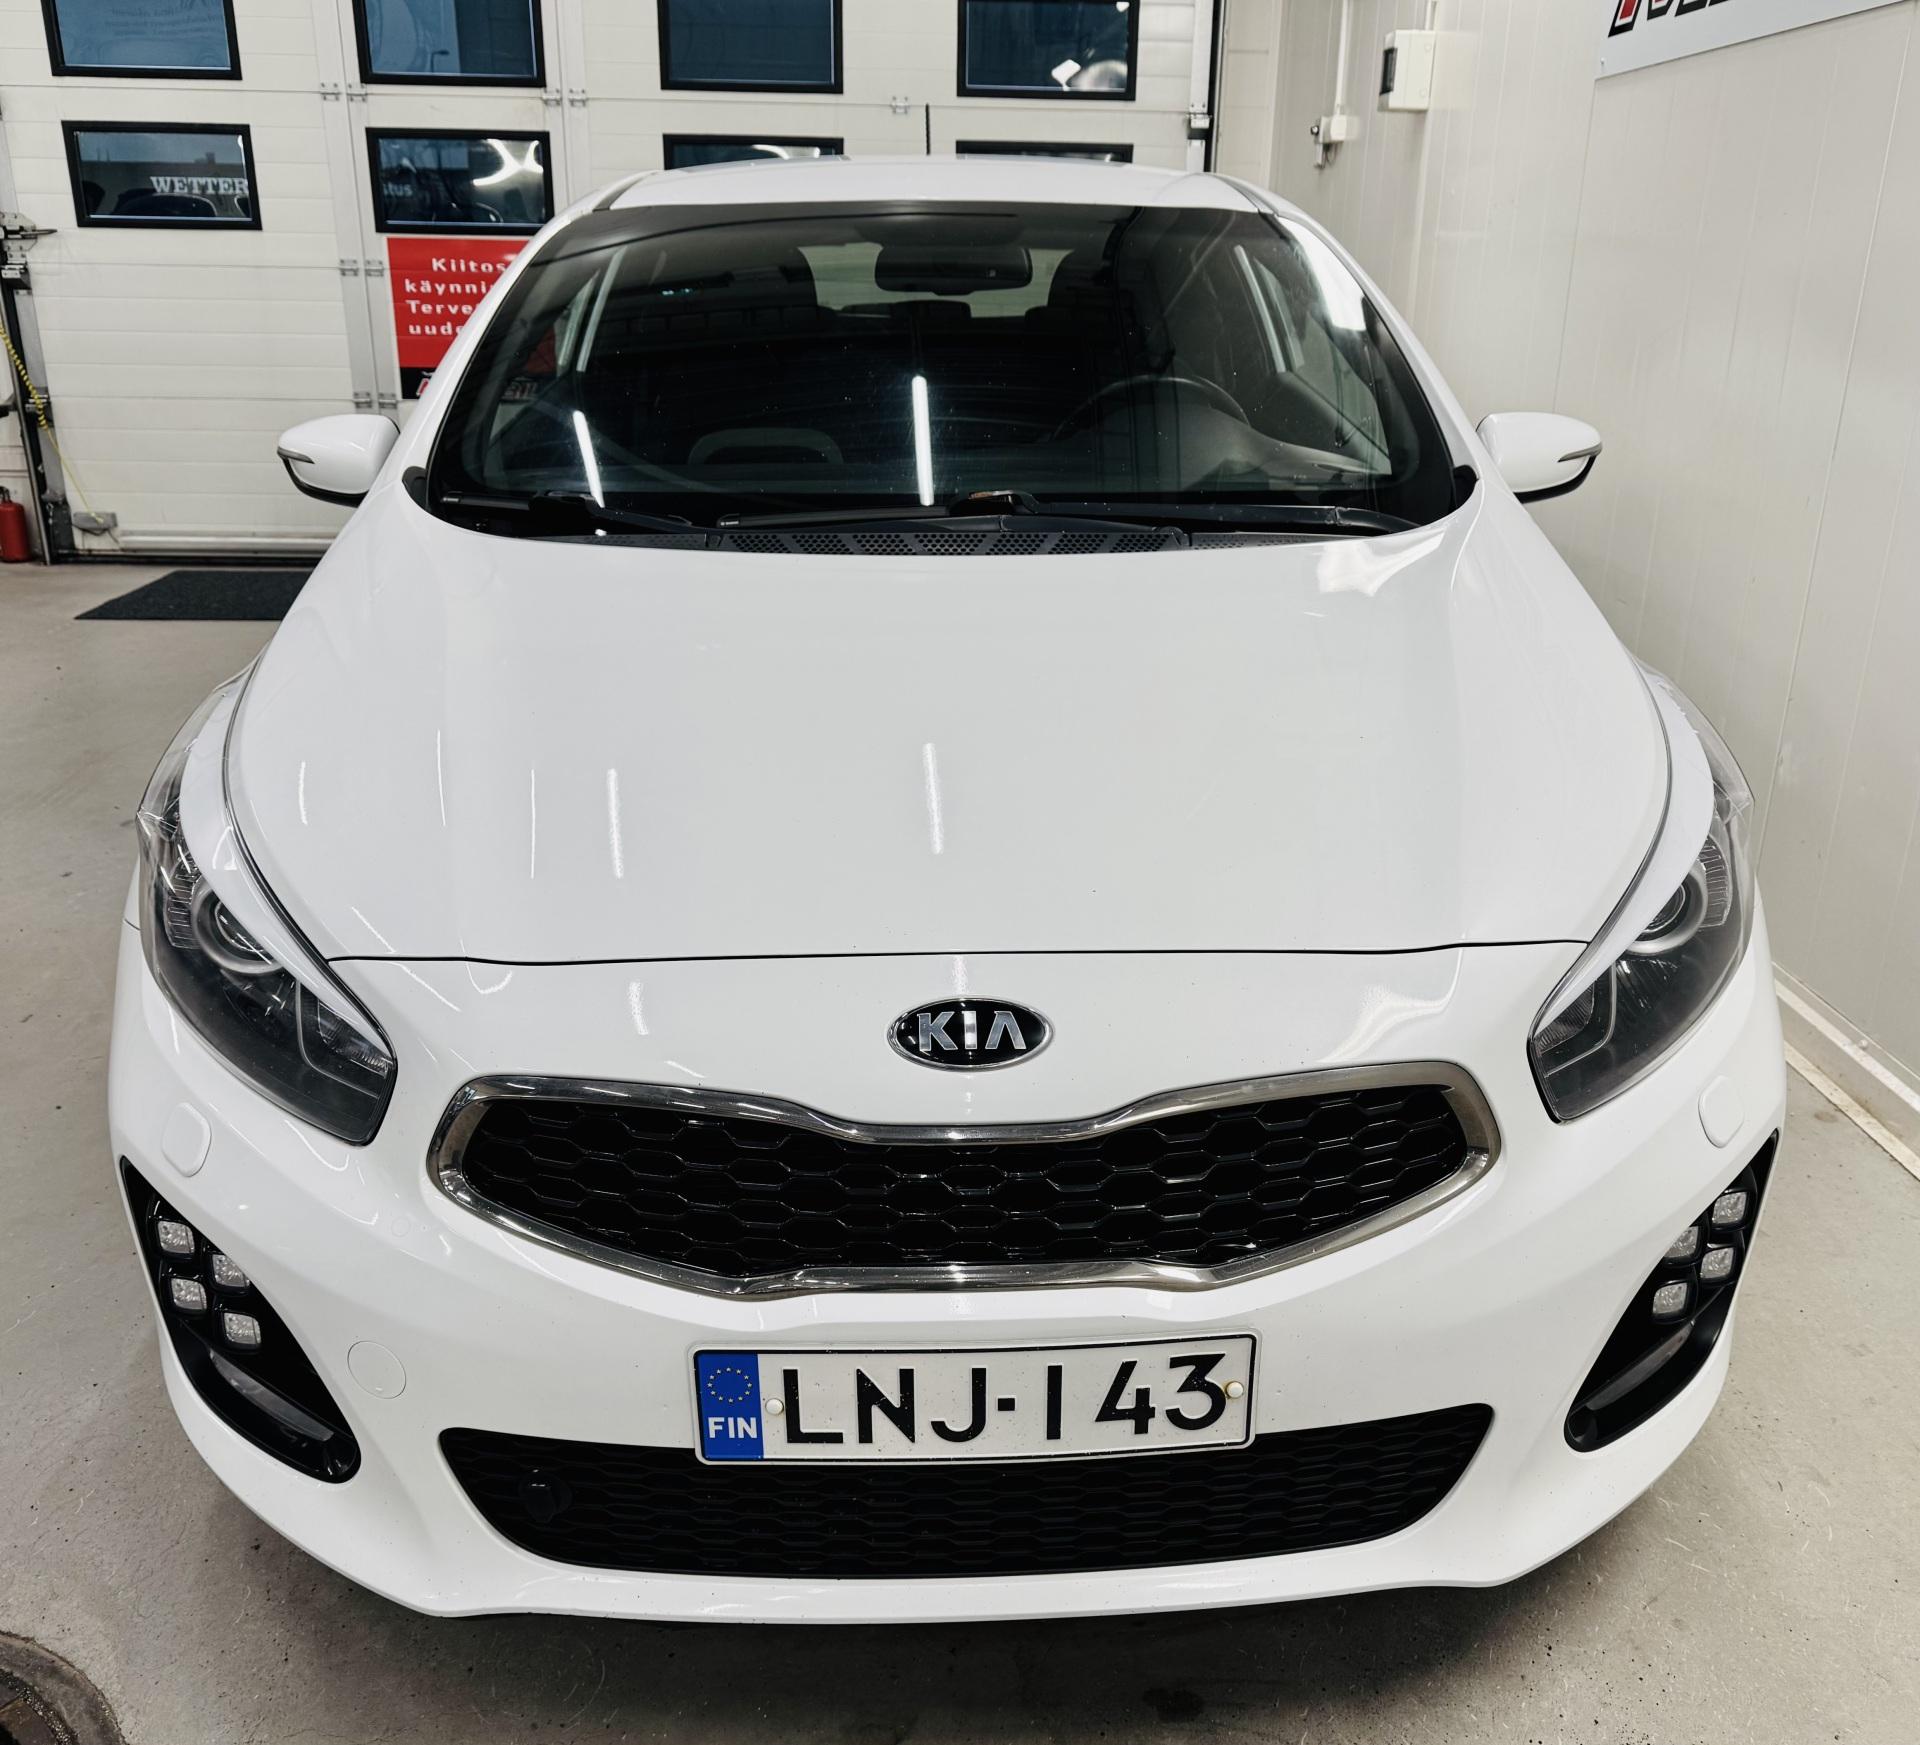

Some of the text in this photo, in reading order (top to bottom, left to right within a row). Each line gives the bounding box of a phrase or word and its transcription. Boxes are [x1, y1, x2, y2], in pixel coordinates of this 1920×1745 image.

[432, 258, 506, 272] Kiitos
[405, 279, 493, 296] käynni
[406, 300, 480, 314] Terve
[917, 1010, 1027, 1051] KIA
[782, 1352, 1227, 1445] LNJ-143
[708, 1416, 758, 1439] FIN
